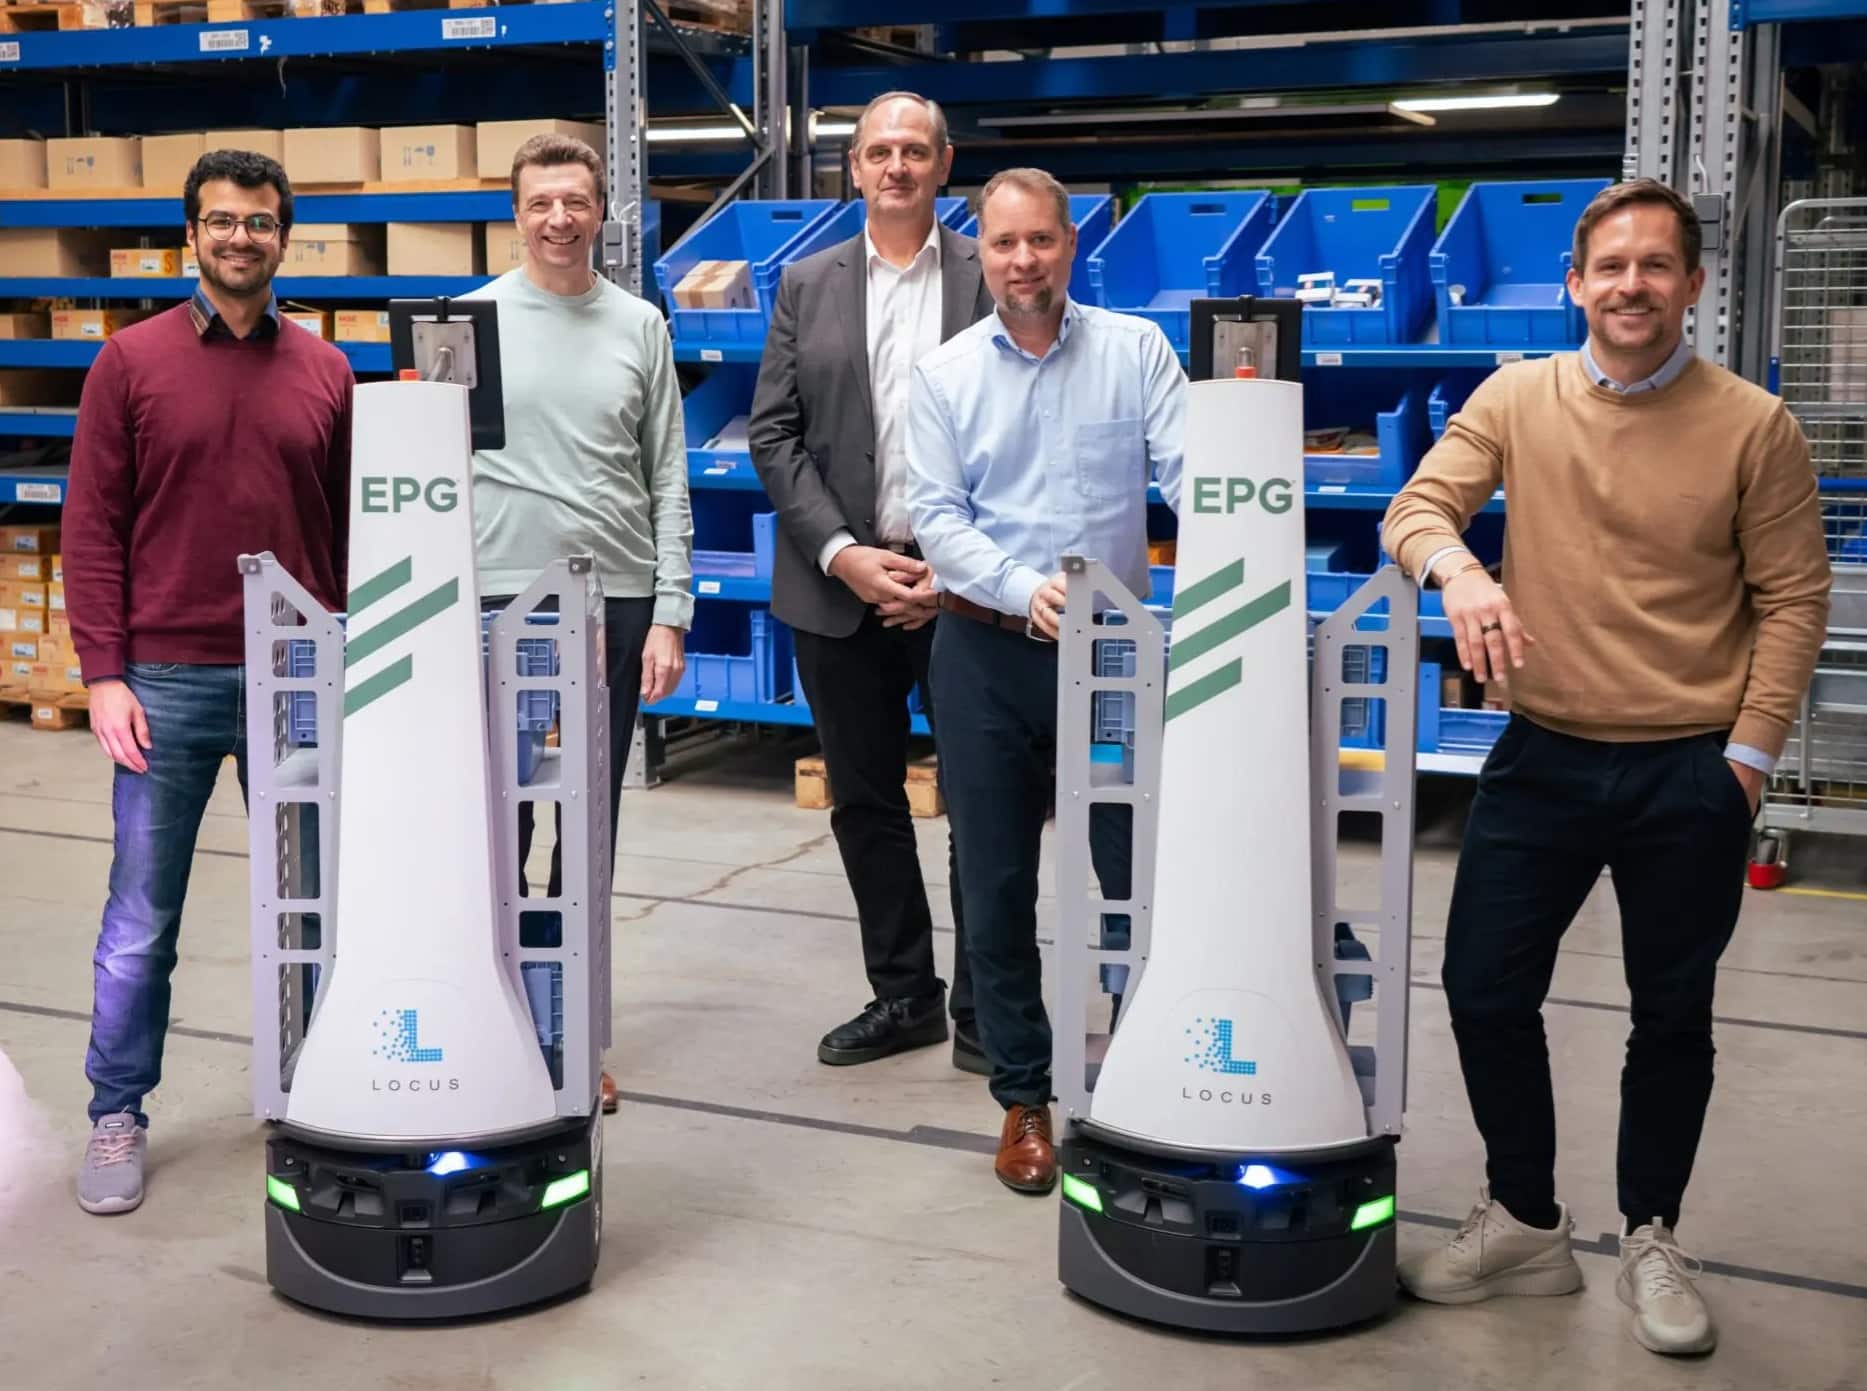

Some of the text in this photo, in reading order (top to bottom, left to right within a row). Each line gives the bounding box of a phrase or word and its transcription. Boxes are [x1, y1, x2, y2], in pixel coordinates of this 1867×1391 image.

[361, 477, 458, 513] EPG
[1193, 477, 1293, 514] EPG
[372, 1079, 460, 1092] LOCUS
[1182, 1087, 1272, 1106] LOCUS
